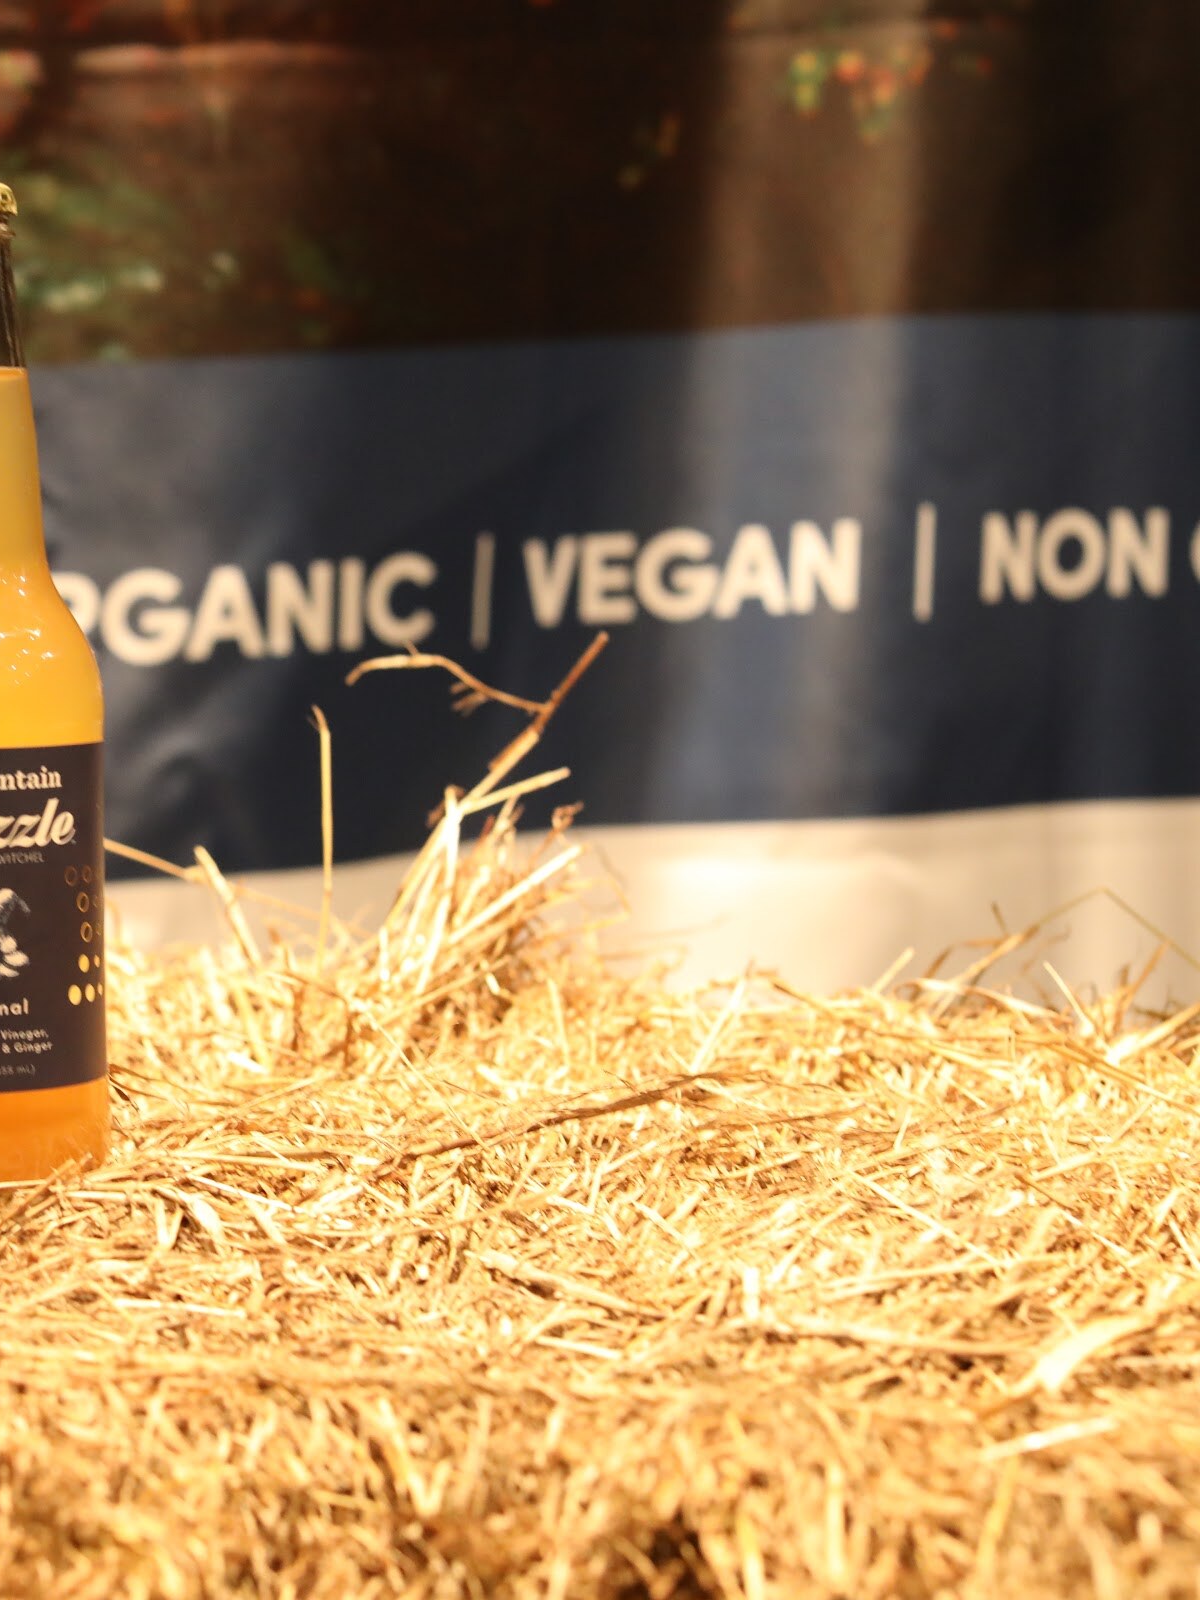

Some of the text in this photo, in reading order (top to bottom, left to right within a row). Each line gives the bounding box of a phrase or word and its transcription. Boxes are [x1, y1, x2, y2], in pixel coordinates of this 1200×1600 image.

[522, 517, 861, 630] VEGAN
[980, 506, 1170, 605] NON
[2, 1042, 11, 1054] &
[14, 1041, 53, 1054] Ginger
